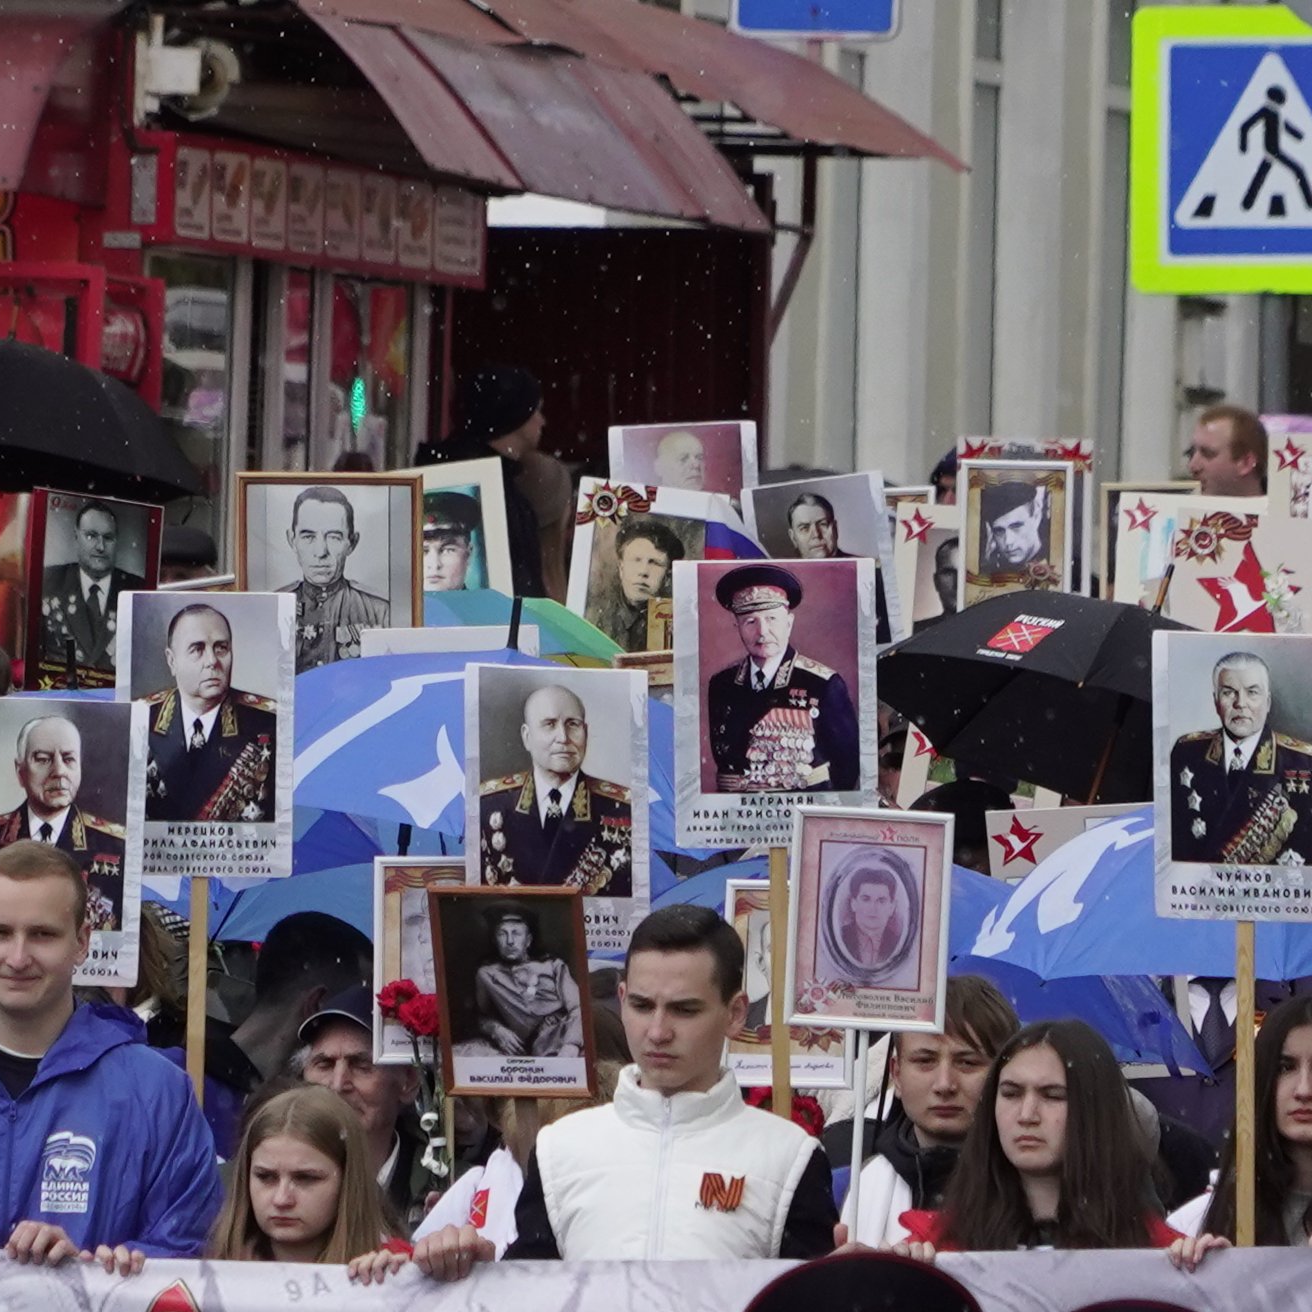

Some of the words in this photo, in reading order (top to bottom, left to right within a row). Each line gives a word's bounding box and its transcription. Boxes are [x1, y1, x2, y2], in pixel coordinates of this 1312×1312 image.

[741, 796, 815, 806] БАГРАМЯН
[693, 810, 729, 819] ИВАН
[737, 809, 792, 819] ХРИСТО
[168, 826, 234, 836] МЕРЕЦКОВ
[731, 824, 762, 832] ГЕРОЙ
[144, 838, 176, 848] РИЛЛ
[182, 839, 277, 849] АФАНАСЬЕВИЧ
[166, 853, 227, 862] СОВЕТСКОГО
[172, 865, 234, 874] СОВЕТСКОГО
[238, 866, 271, 874] СОЮЗА
[1216, 871, 1272, 883] ЧУЙКОВ
[1171, 885, 1235, 897] ВАСИЛИЙ
[1215, 905, 1280, 914] СОВЕТСКОГО
[590, 940, 622, 948] СОЮЗА
[82, 968, 119, 977] СОЮЗА
[42, 1181, 89, 1191] ЕДИНАЯ
[41, 1192, 88, 1201] РОССИЯ
[285, 1279, 303, 1302] 9
